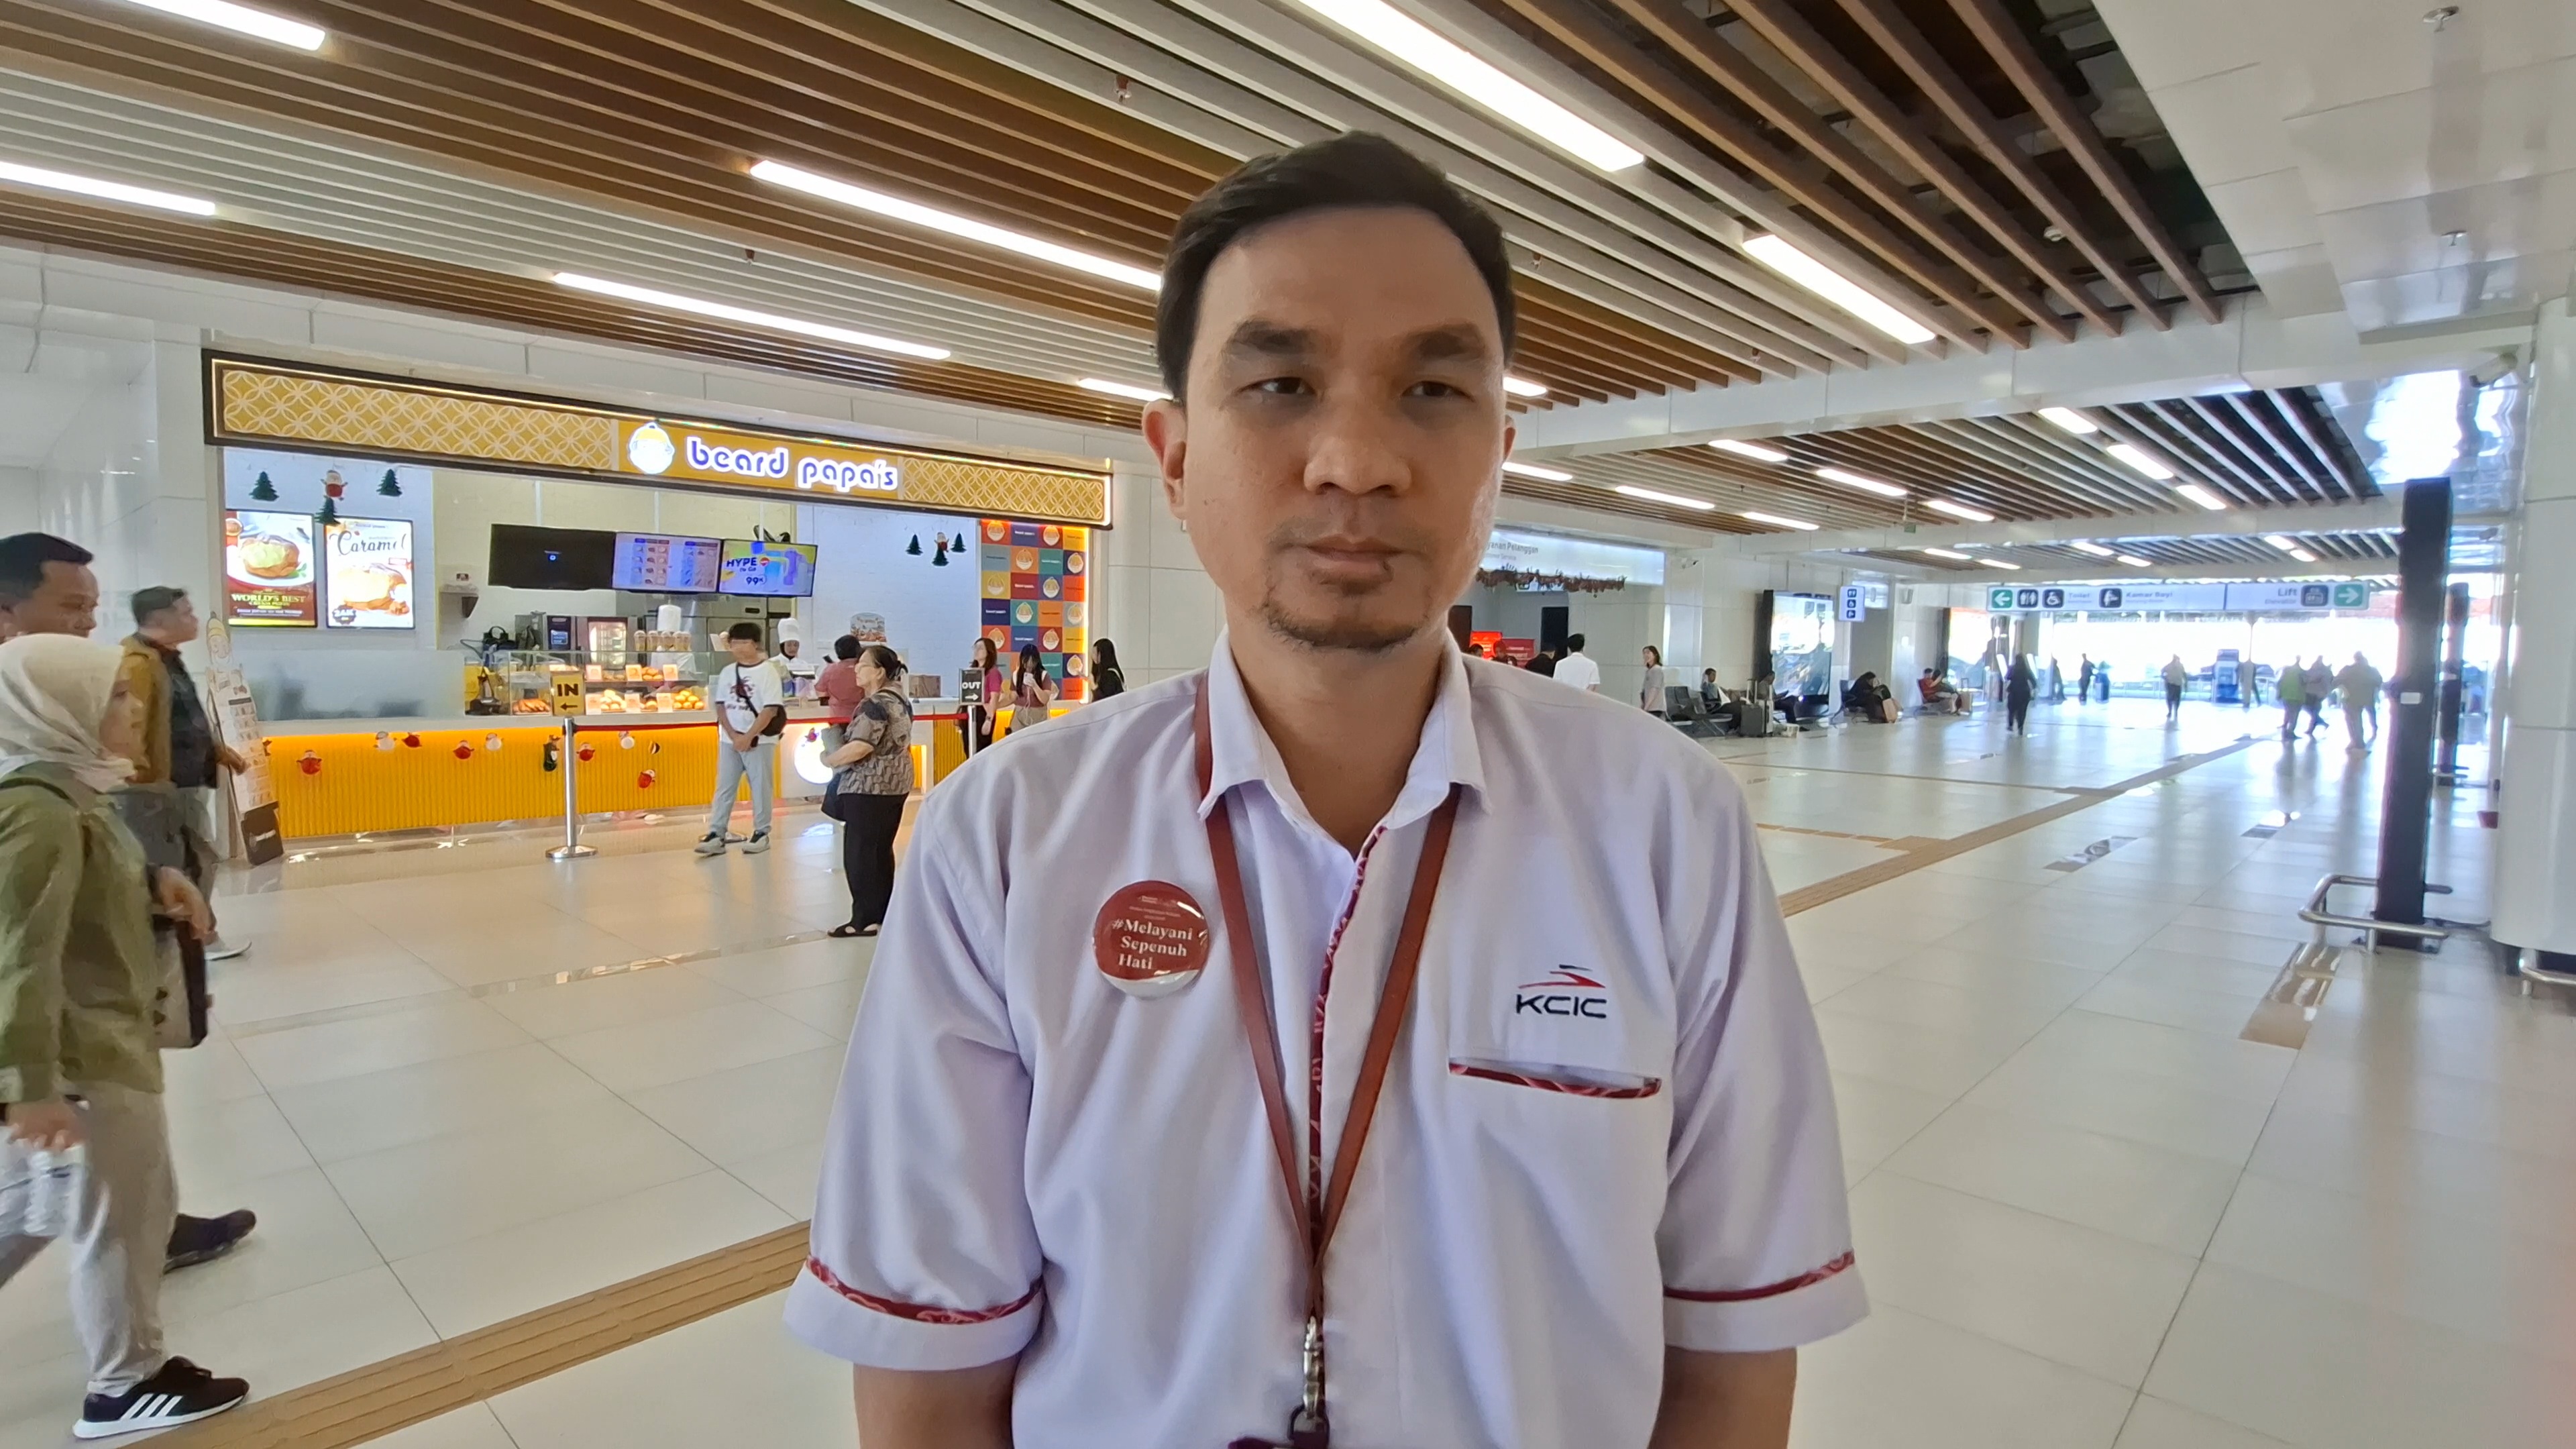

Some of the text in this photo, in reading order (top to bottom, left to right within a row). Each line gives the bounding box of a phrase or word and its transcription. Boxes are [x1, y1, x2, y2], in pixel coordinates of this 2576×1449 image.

[689, 438, 896, 490] beard papa's
[727, 557, 757, 567] HYPE
[231, 594, 280, 602] WORLD'S
[2278, 588, 2298, 596] Lift
[557, 683, 579, 697] IN
[961, 682, 981, 690] OUT
[1112, 918, 1193, 940] #Melayani
[1120, 936, 1187, 957] Sepenuh
[1118, 953, 1152, 969] Hati
[1516, 994, 1607, 1018] KCIC
